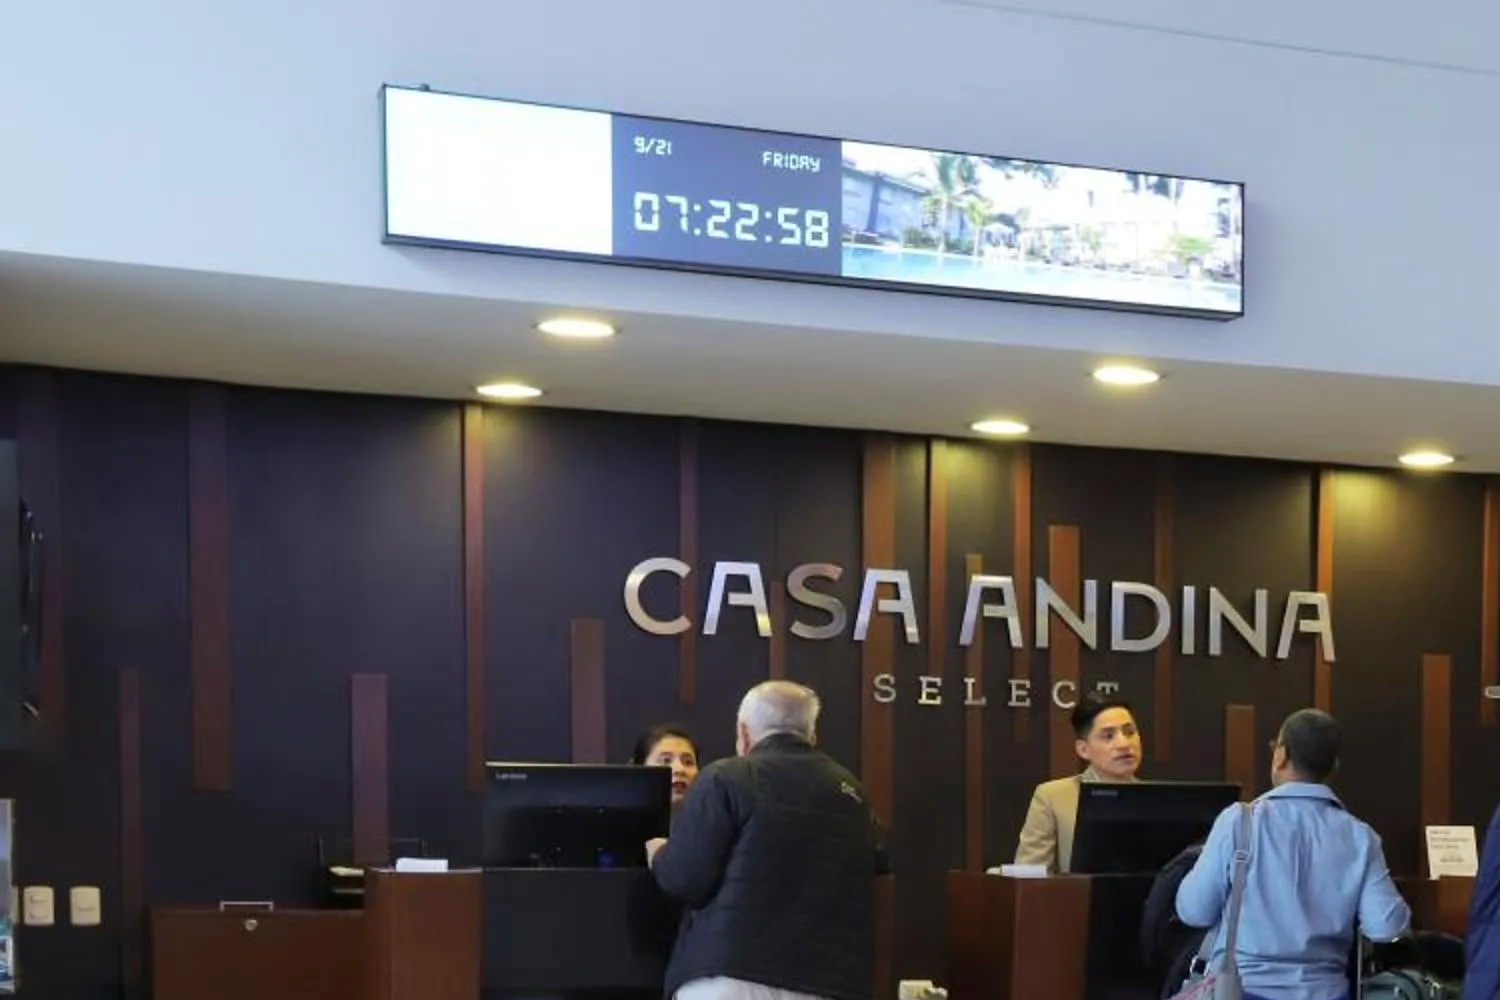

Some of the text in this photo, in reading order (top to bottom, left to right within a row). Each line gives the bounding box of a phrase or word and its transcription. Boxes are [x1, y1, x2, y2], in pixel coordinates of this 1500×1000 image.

[634, 136, 672, 155] 9/21
[762, 151, 821, 172] FRIDAY
[634, 191, 829, 248] 07:22:58
[623, 556, 1336, 662] CASA ANDINA
